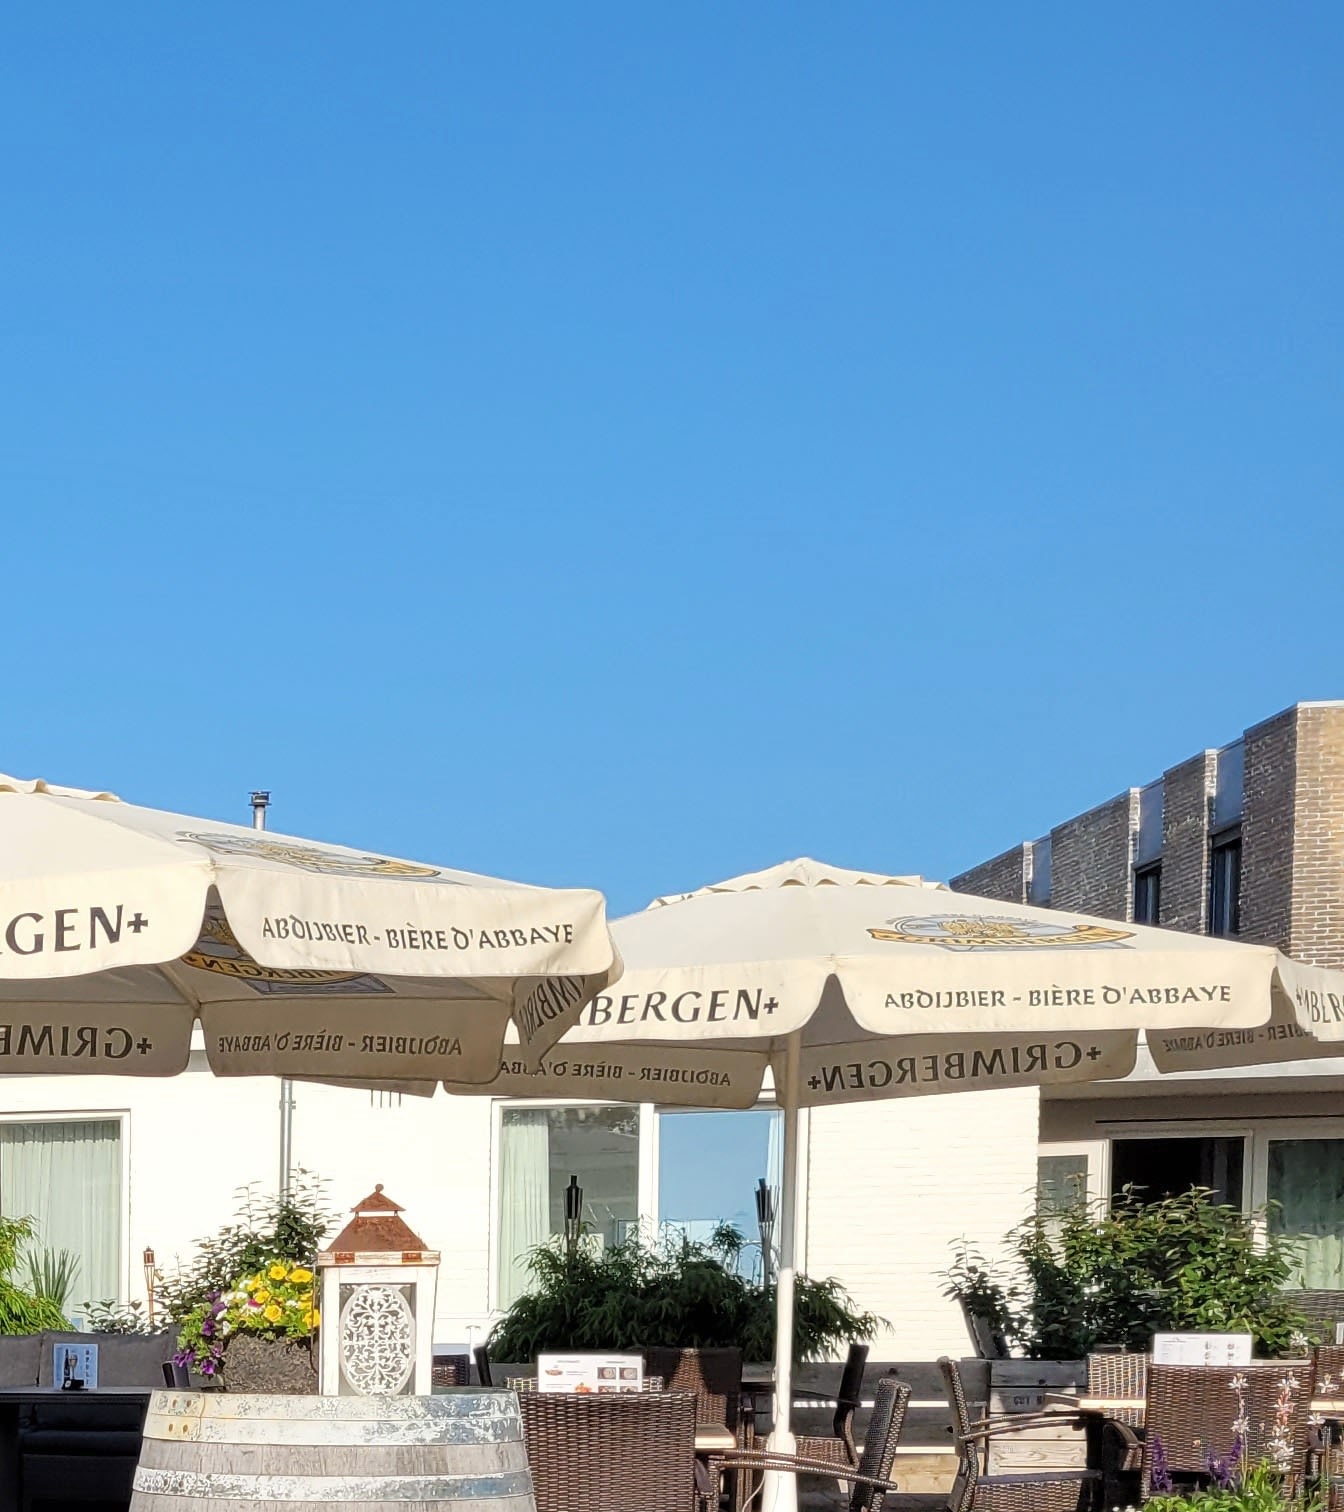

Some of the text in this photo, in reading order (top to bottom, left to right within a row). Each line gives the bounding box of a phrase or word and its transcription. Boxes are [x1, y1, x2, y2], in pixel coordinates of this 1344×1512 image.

[262, 914, 574, 951] ABDIJBIER BIÈRE D'ABBAYE
[576, 988, 764, 1026] BERGEN
[884, 984, 1231, 1010] ABDIJBIER BIÈRE D'ABBAYE
